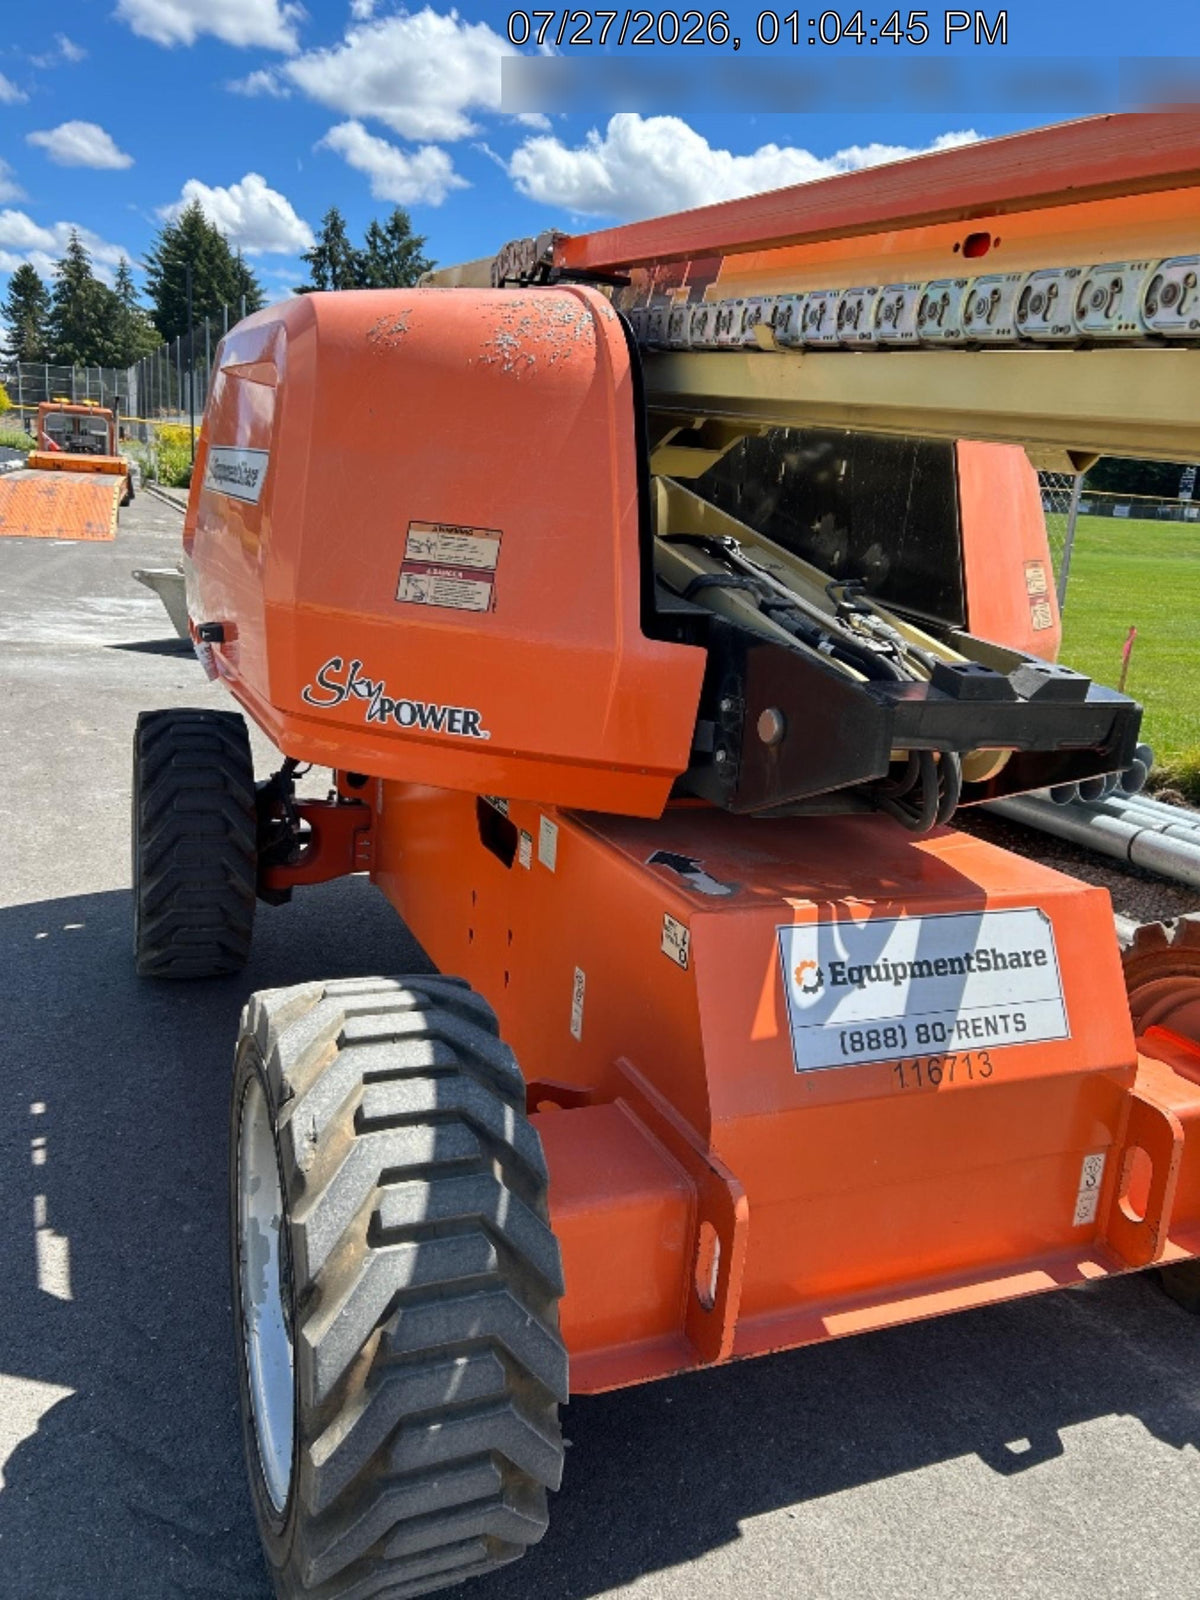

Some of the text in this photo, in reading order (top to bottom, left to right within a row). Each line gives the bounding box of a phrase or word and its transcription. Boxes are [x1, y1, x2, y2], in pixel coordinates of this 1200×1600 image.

[828, 948, 1048, 989] EquipmentShare
[840, 1012, 1027, 1055] (888) 80-RENTS
[893, 1051, 994, 1089] 116713
